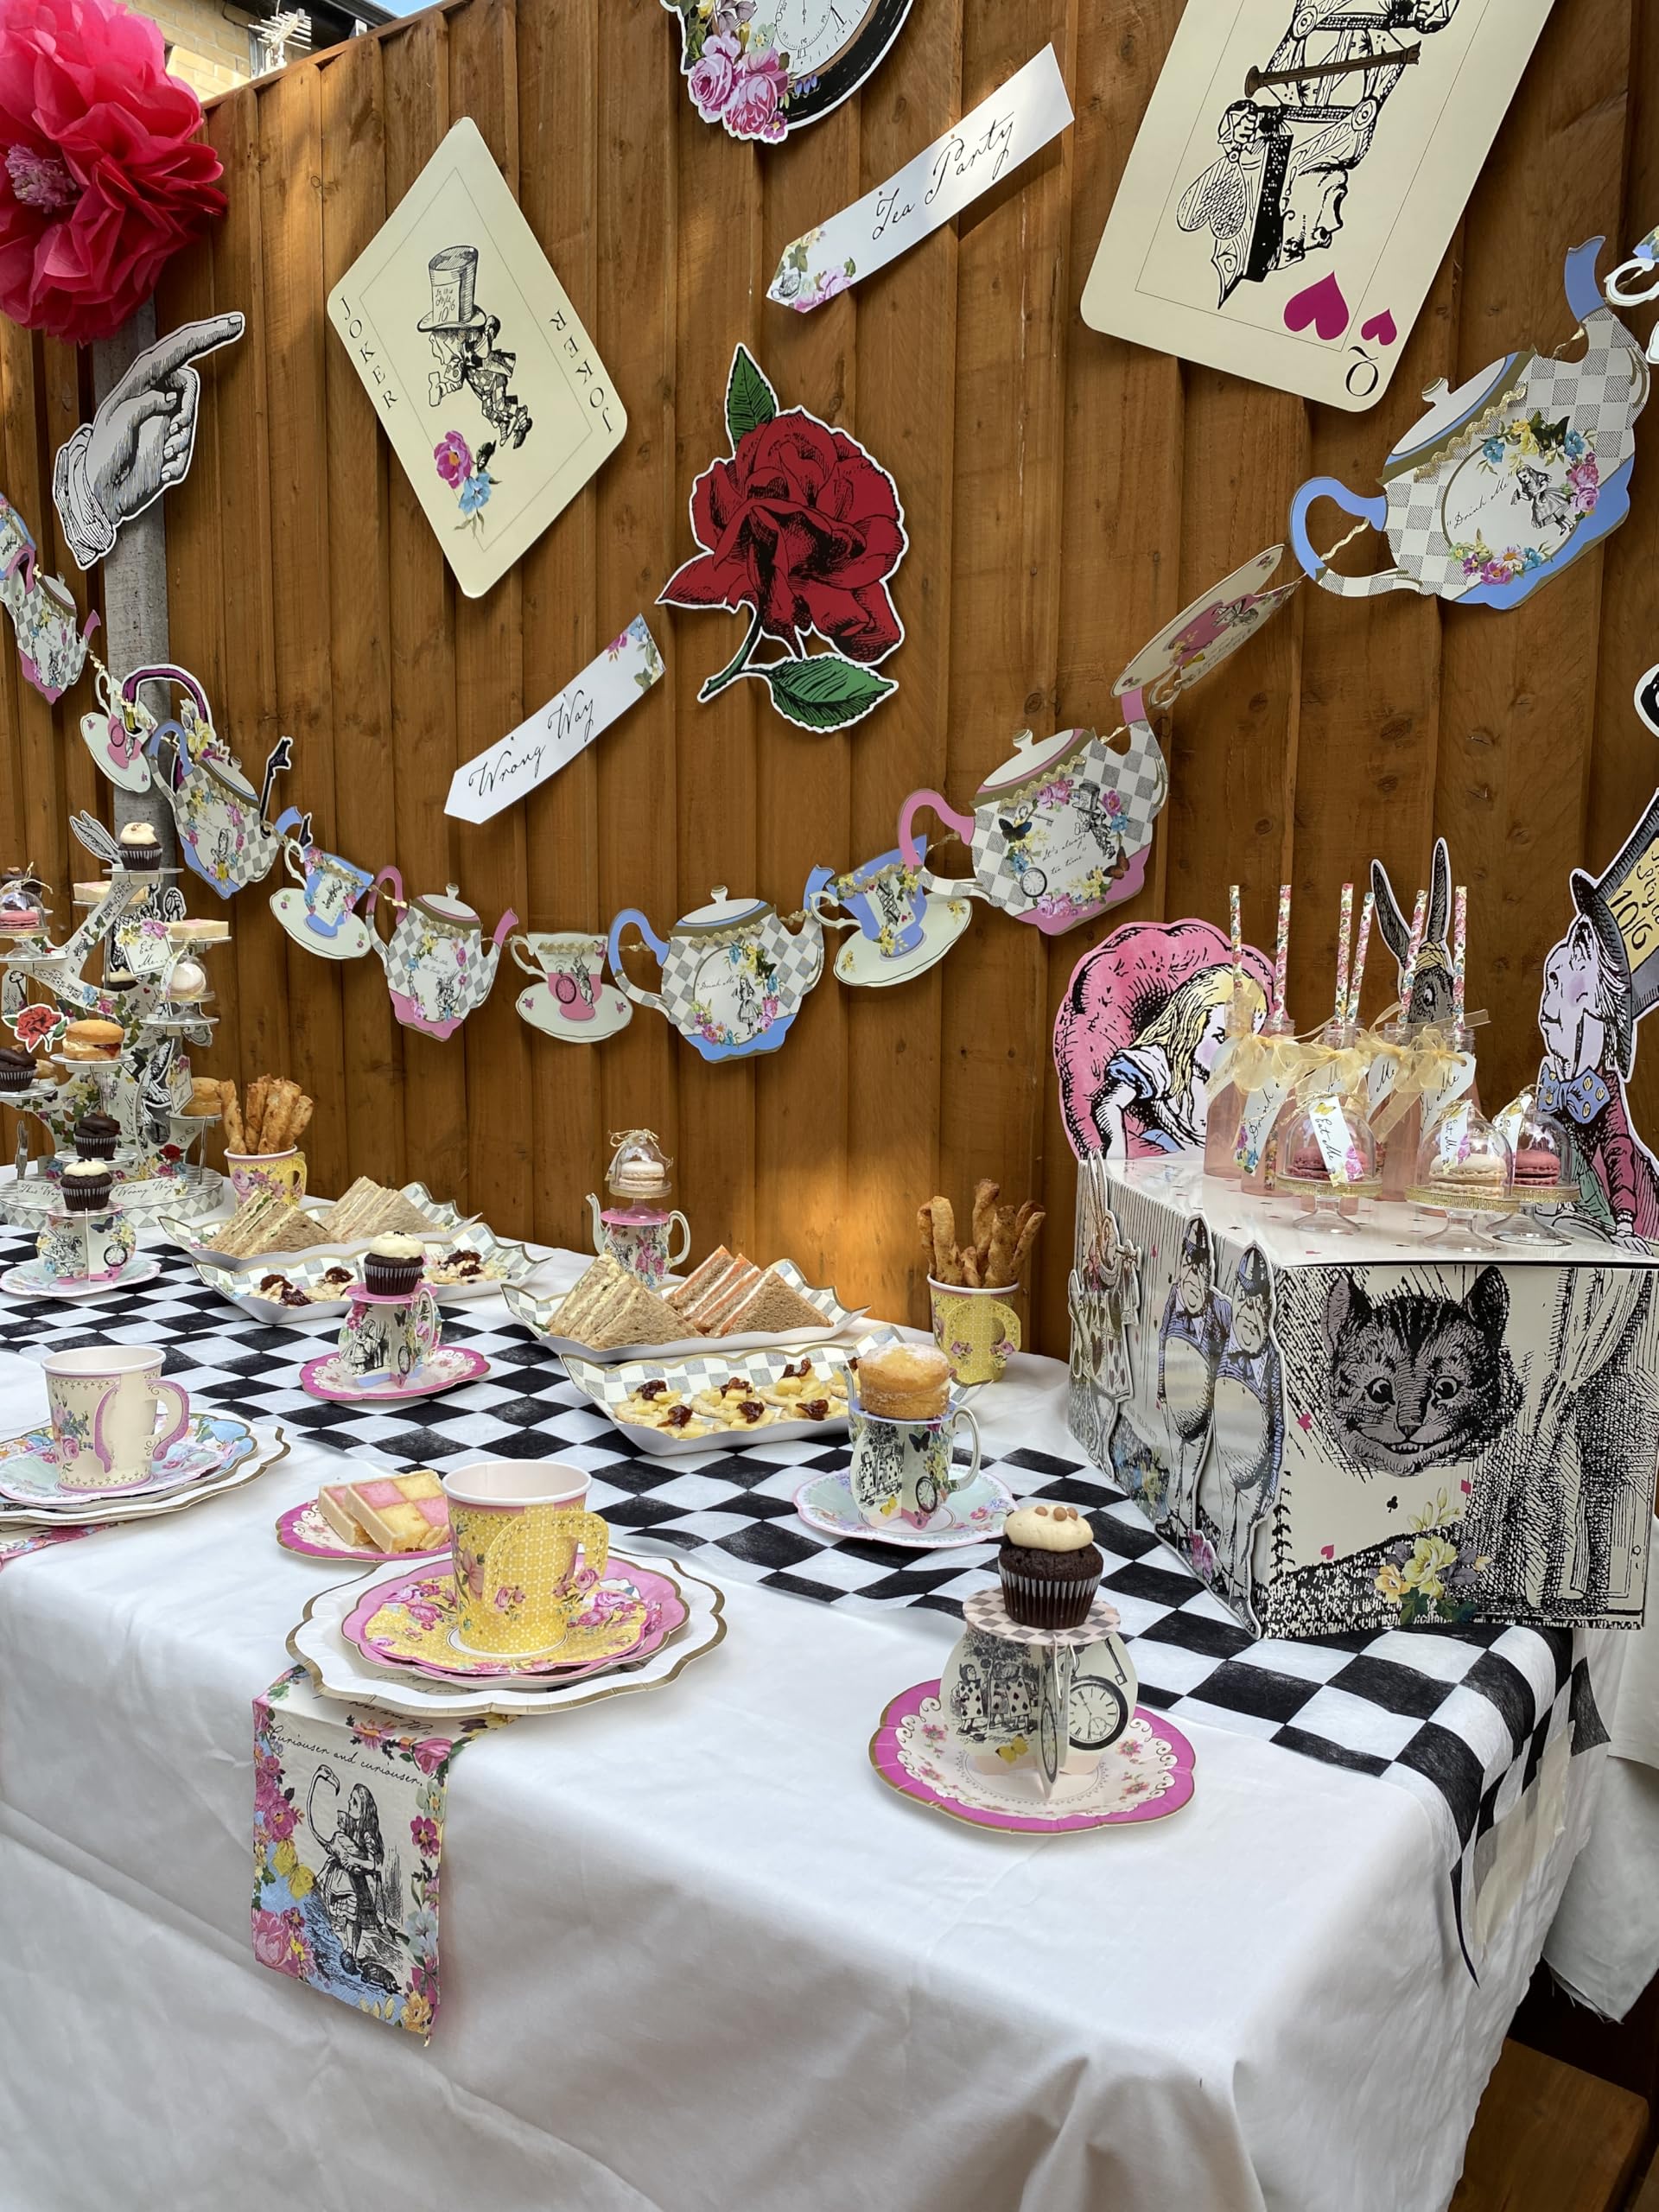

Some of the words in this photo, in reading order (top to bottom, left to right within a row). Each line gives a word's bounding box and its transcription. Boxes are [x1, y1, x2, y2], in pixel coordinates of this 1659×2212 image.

[872, 188, 916, 240] Tea
[924, 111, 1015, 206] Party
[339, 296, 399, 410] JOKER
[548, 308, 614, 435] JOKER
[1344, 345, 1380, 397] Q
[468, 745, 547, 798] Wrong
[547, 690, 594, 743] Way
[138, 939, 160, 955] Eat
[1314, 1118, 1333, 1141] Eat
[268, 1725, 330, 1756] Curiouser
[333, 1751, 356, 1765] and
